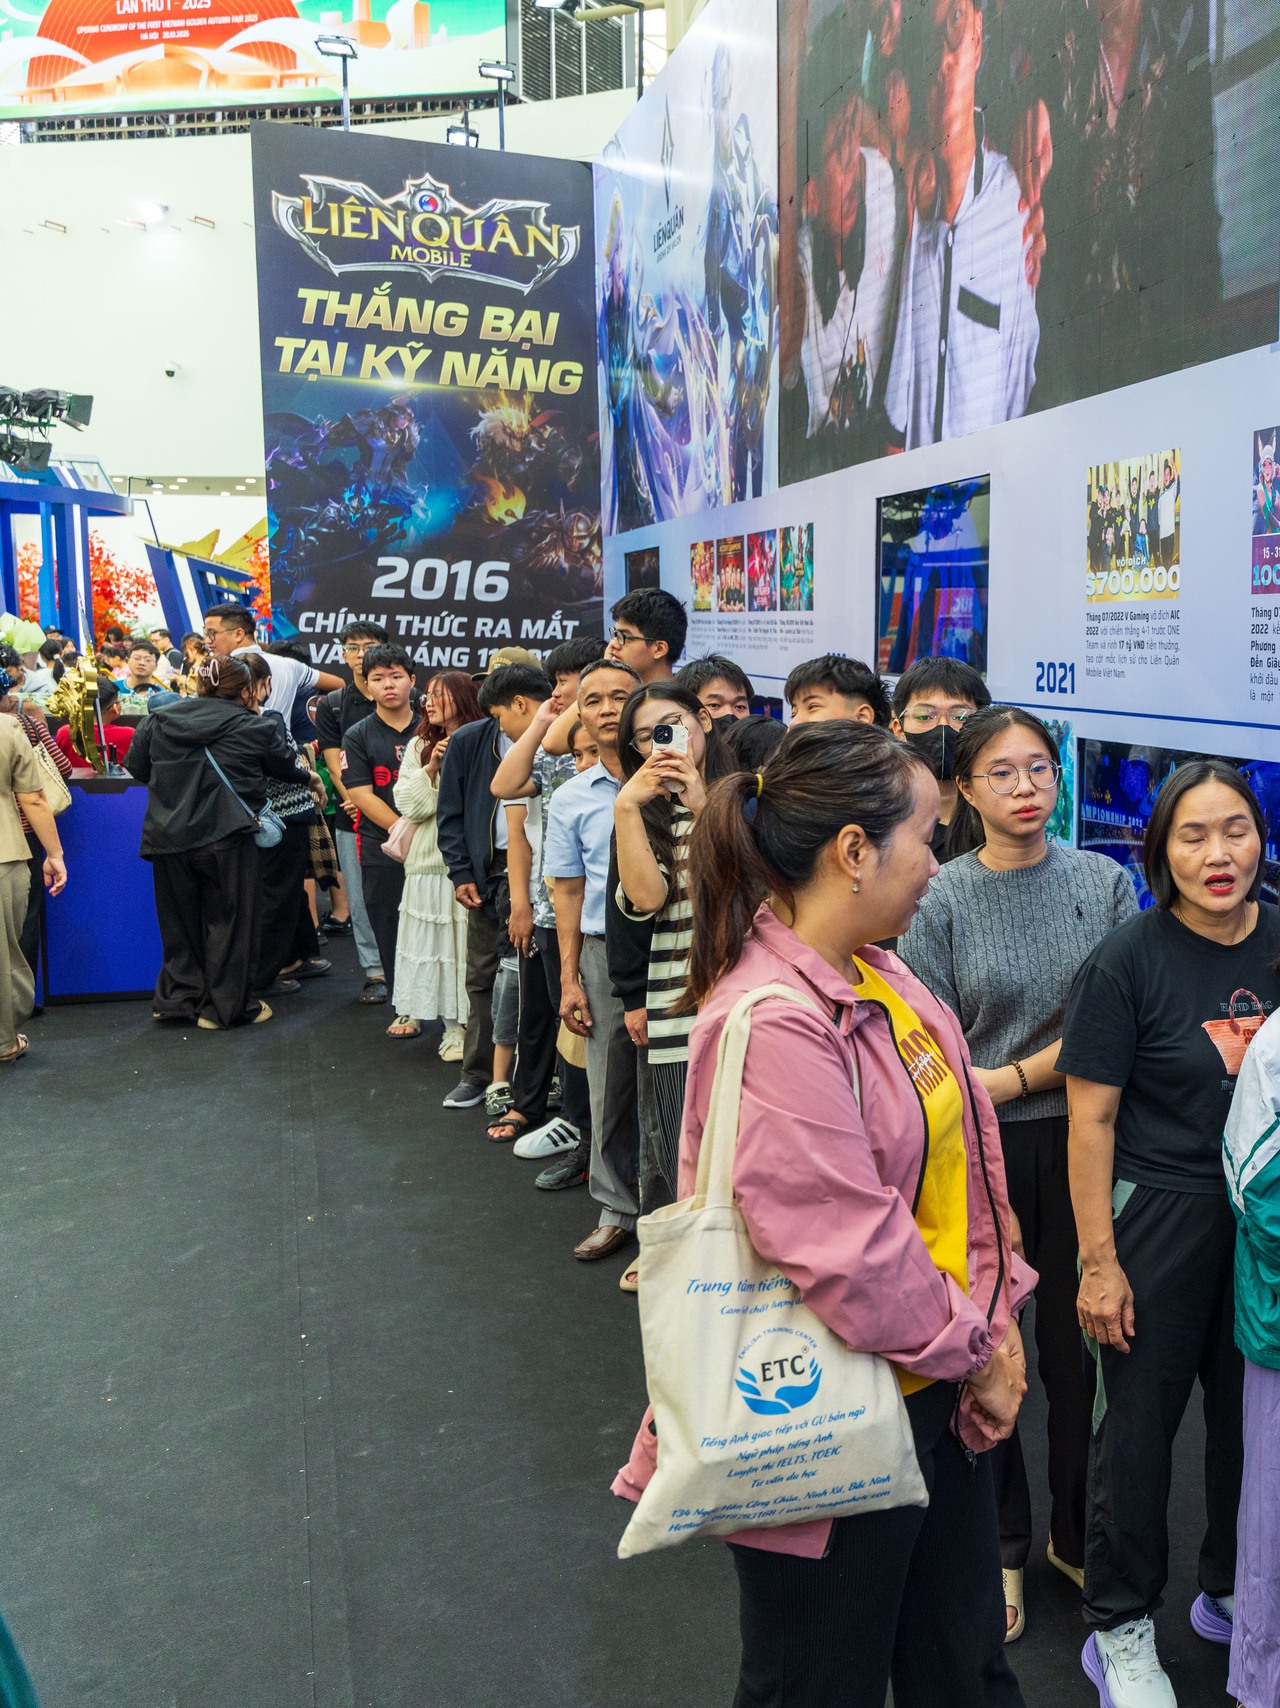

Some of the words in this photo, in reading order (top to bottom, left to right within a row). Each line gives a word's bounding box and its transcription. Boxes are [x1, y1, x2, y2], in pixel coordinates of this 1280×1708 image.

[390, 243, 472, 269] MOBILE
[297, 281, 470, 337] THẮNG
[479, 305, 560, 350] BẠI
[274, 336, 348, 381] TẠI
[359, 341, 432, 382] KỸ
[438, 347, 584, 395] NĂNG
[1263, 547, 1270, 559] 15
[371, 556, 510, 602] 2016
[1086, 612, 1101, 624] Tháng
[1102, 612, 1124, 621] 07/2022
[1129, 610, 1150, 623] Gaming
[1251, 607, 1272, 620] Tháng
[395, 611, 468, 638] THỨC
[473, 619, 512, 639] RA
[518, 610, 579, 641] MẮT
[1086, 626, 1099, 635] 2022
[1250, 623, 1269, 635] 2022
[1250, 640, 1276, 653] Phương
[1250, 654, 1264, 668] Đến
[1035, 661, 1076, 696] 2021
[1250, 689, 1256, 701] là
[686, 1278, 733, 1297] Trung
[737, 1280, 755, 1293] tâm
[757, 1274, 794, 1292] tiếng
[738, 1334, 762, 1360] ENGLISH
[763, 1327, 794, 1335] TRAINING
[795, 1330, 818, 1350] CENTER
[760, 1355, 806, 1382] ETC
[700, 1436, 727, 1449] Tiếng
[729, 1432, 749, 1446] Anh
[751, 1430, 773, 1446] giao
[775, 1423, 793, 1435] tiếp
[828, 1411, 846, 1422] bản
[814, 1431, 833, 1444] Anh
